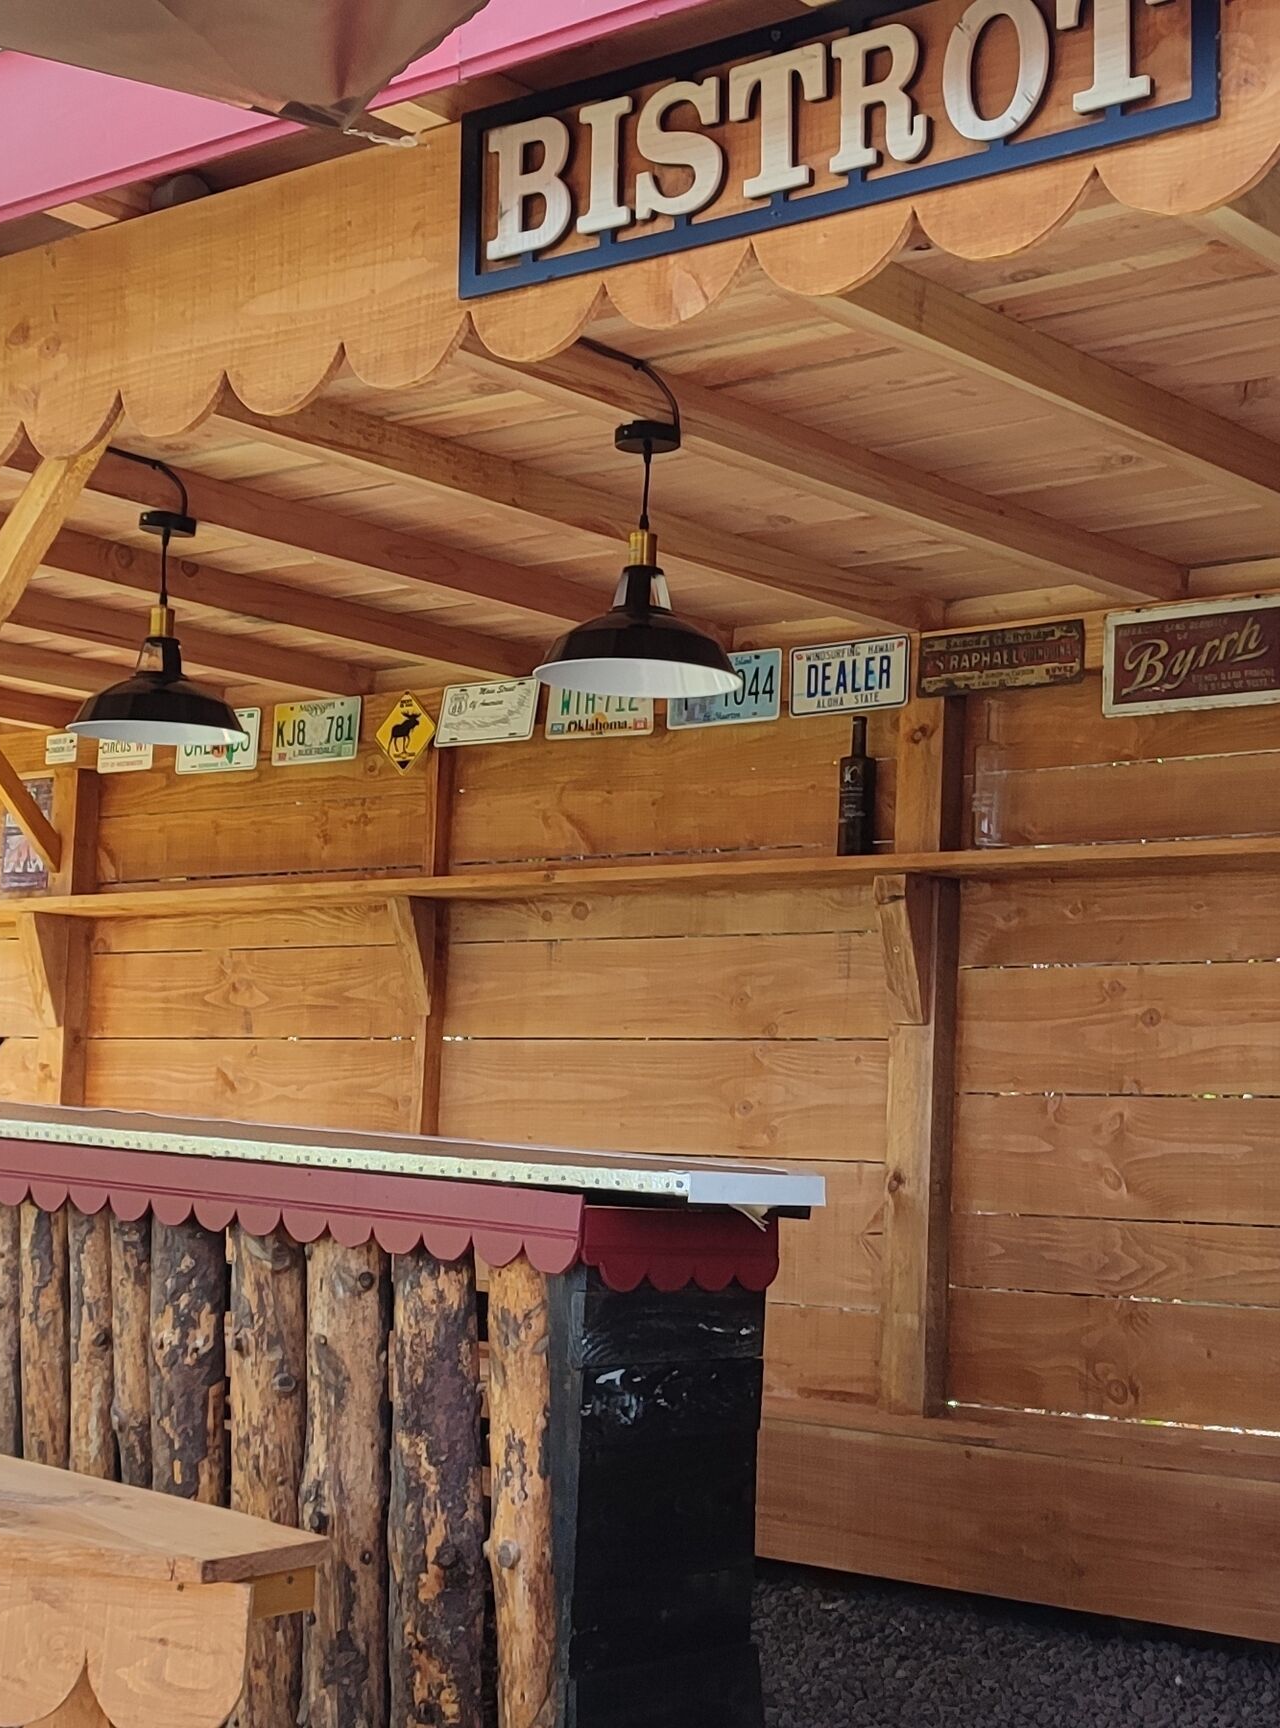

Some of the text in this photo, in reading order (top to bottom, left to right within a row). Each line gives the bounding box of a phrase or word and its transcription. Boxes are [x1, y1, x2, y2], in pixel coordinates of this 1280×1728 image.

[486, 0, 1170, 261] BISTROT
[806, 642, 895, 662] WINDSURFING HAWAII
[1122, 616, 1269, 697] Byrrh
[806, 655, 891, 698] DEALER
[816, 691, 880, 709] ALOHA STATE
[276, 714, 353, 748] KJ8 781
[568, 718, 627, 734] Oklahoma
